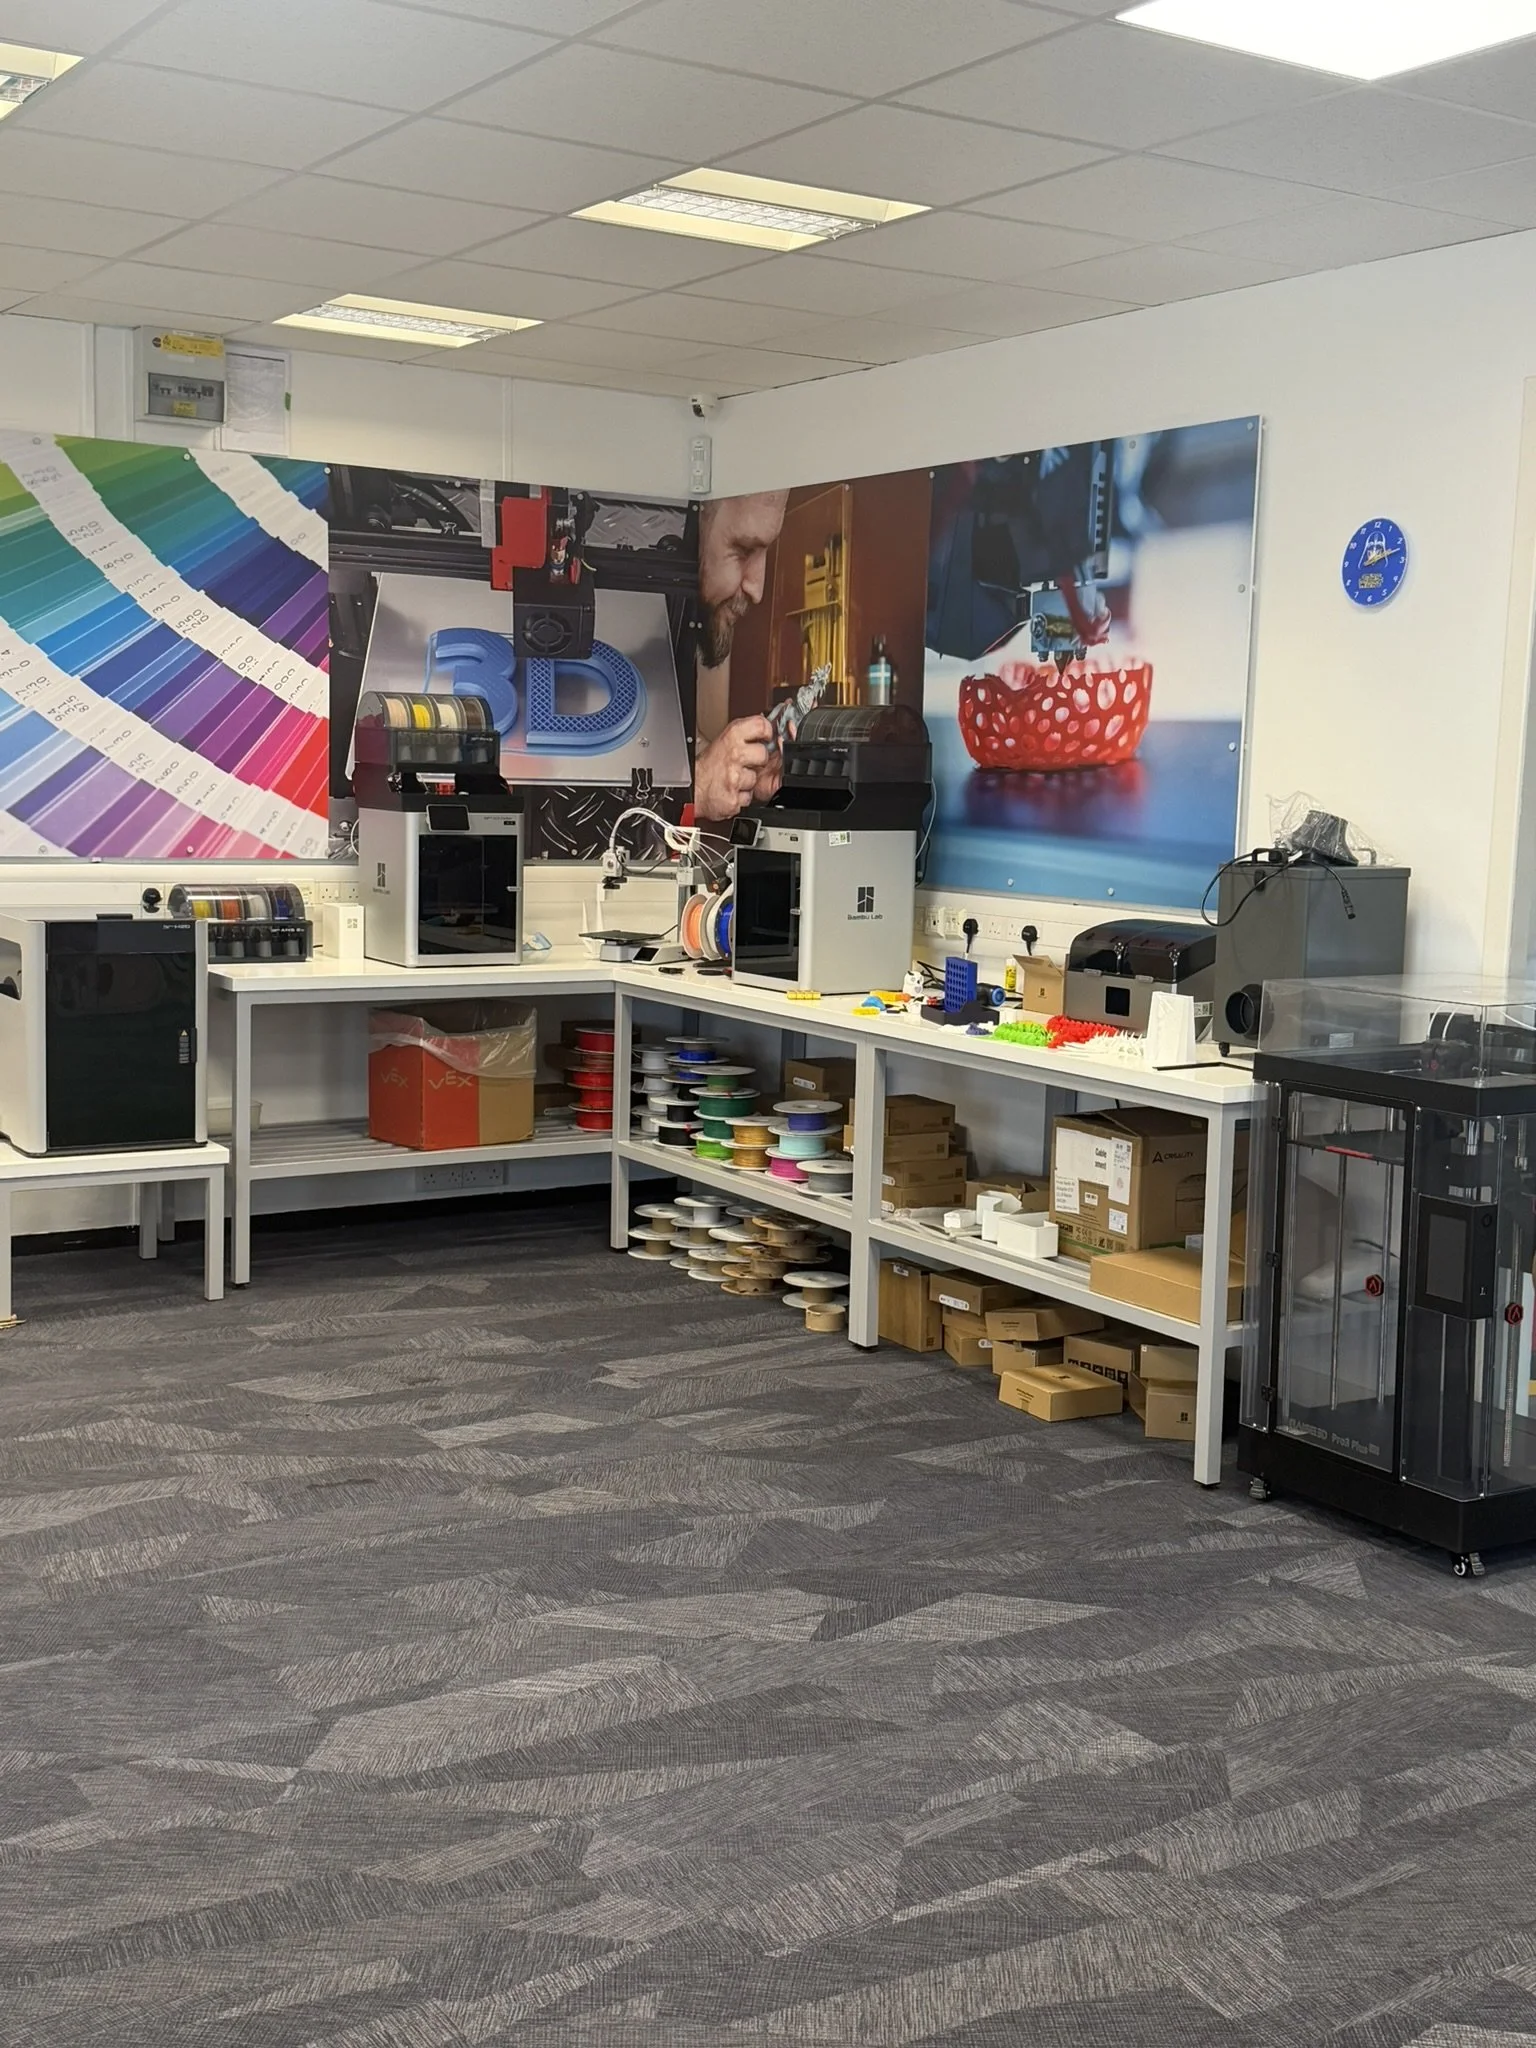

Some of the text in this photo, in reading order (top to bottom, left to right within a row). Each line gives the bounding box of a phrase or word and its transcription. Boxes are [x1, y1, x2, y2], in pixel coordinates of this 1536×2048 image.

[425, 626, 648, 756] 3D
[380, 1068, 409, 1089] VEX
[428, 1070, 473, 1090] VEX
